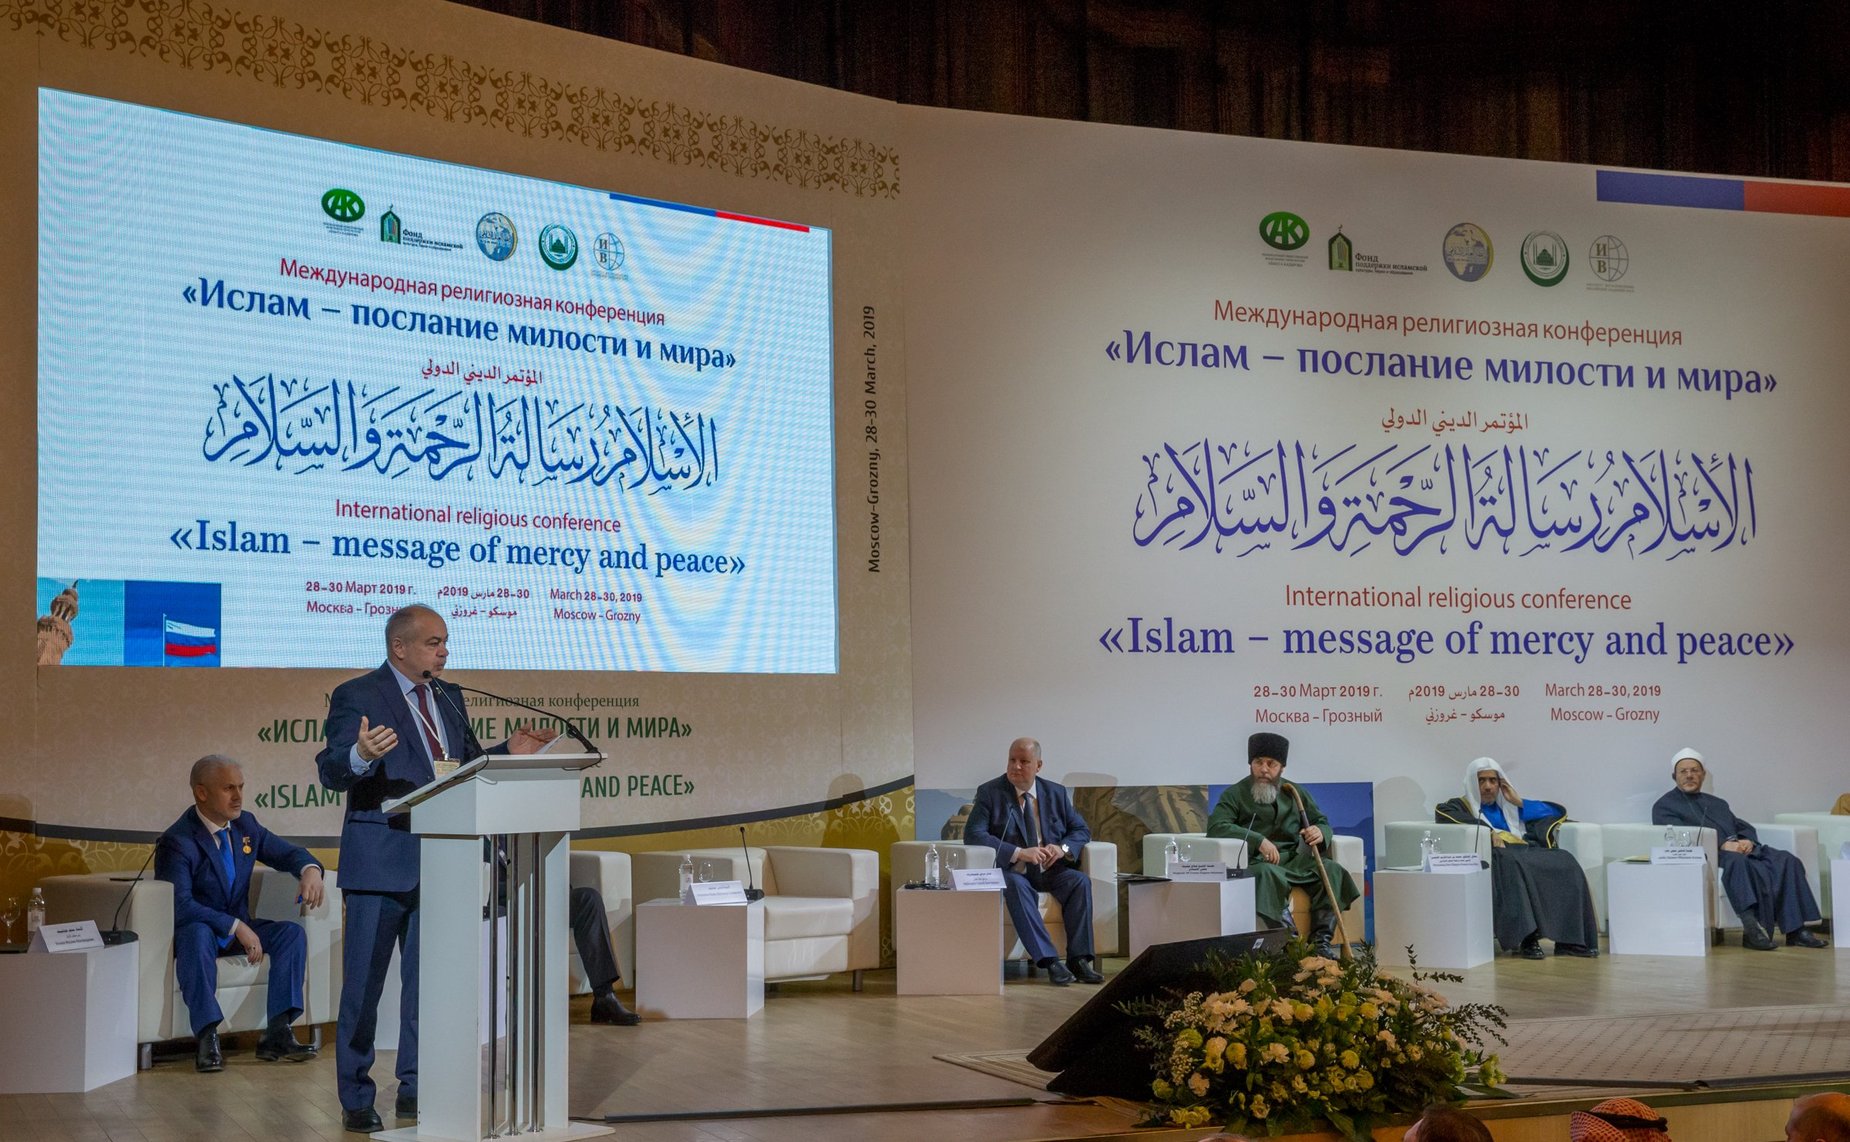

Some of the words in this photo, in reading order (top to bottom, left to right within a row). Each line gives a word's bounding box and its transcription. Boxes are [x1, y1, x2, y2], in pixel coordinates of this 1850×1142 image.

[1355, 253, 1379, 262] Фонд
[280, 258, 437, 296] Международная
[441, 283, 552, 311] религиозная
[556, 299, 665, 326] конференция
[183, 277, 311, 320] «Ислам
[352, 305, 499, 340] послание
[508, 324, 627, 356] милости
[635, 339, 651, 359] и
[661, 342, 736, 372] мира»
[863, 305, 876, 340] 2019
[1214, 300, 1398, 332] Международная
[1403, 314, 1538, 338] религиозная
[1543, 320, 1682, 348] конференция
[422, 359, 459, 379] الدولي
[464, 364, 501, 385] الديني
[865, 344, 878, 394] March,
[1105, 330, 1250, 370] «Ислам
[1297, 348, 1473, 380] послание
[1486, 358, 1634, 388] милости
[1646, 366, 1665, 389] и
[1678, 367, 1777, 400] мира»
[503, 369, 542, 387] المؤتمر
[1382, 408, 1427, 433] الدولي
[1432, 410, 1477, 436] الديني
[1479, 412, 1528, 434] المؤتمر
[336, 499, 450, 523] International
[457, 507, 528, 530] religious
[533, 512, 621, 533] conference
[170, 520, 291, 554] «Islam
[332, 535, 460, 569] message
[470, 535, 501, 563] of
[506, 543, 591, 575] mercy
[599, 543, 648, 570] and
[655, 550, 746, 578] peace»
[345, 580, 377, 596] Март
[380, 583, 406, 595] 2019
[471, 588, 495, 600] مارس
[550, 588, 582, 601] March
[620, 593, 643, 602] 2019
[307, 600, 353, 614] Москва
[365, 602, 401, 617] Грозн
[1286, 585, 1421, 607] International
[1428, 586, 1515, 613] religious
[1521, 588, 1632, 609] conference
[488, 606, 518, 619] موسكو
[554, 608, 596, 621] Moscow
[605, 609, 641, 625] Grozny
[1099, 616, 1235, 653] «Islam
[1283, 628, 1434, 664] message
[1445, 620, 1484, 655] of
[1490, 631, 1595, 664] mercy
[1606, 622, 1668, 655] and
[1677, 631, 1795, 664] peace»
[1300, 683, 1337, 700] Март
[1340, 685, 1370, 697] 2019
[1373, 686, 1383, 697] г.
[1449, 685, 1478, 700] مارس
[1545, 683, 1585, 697] March
[1634, 685, 1662, 697] 2019
[465, 696, 544, 708] елигиозная
[549, 693, 639, 712] конференция
[1255, 708, 1310, 723] Москва
[1322, 708, 1383, 726] Грозный
[1425, 707, 1458, 724] غروزني
[1470, 707, 1506, 724] موسكو
[1551, 707, 1605, 722] Moscow
[1615, 707, 1660, 723] Grozny
[608, 717, 619, 739] И
[627, 717, 693, 739] МИРА»
[581, 775, 621, 799] AND
[627, 774, 695, 798] PEACE»
